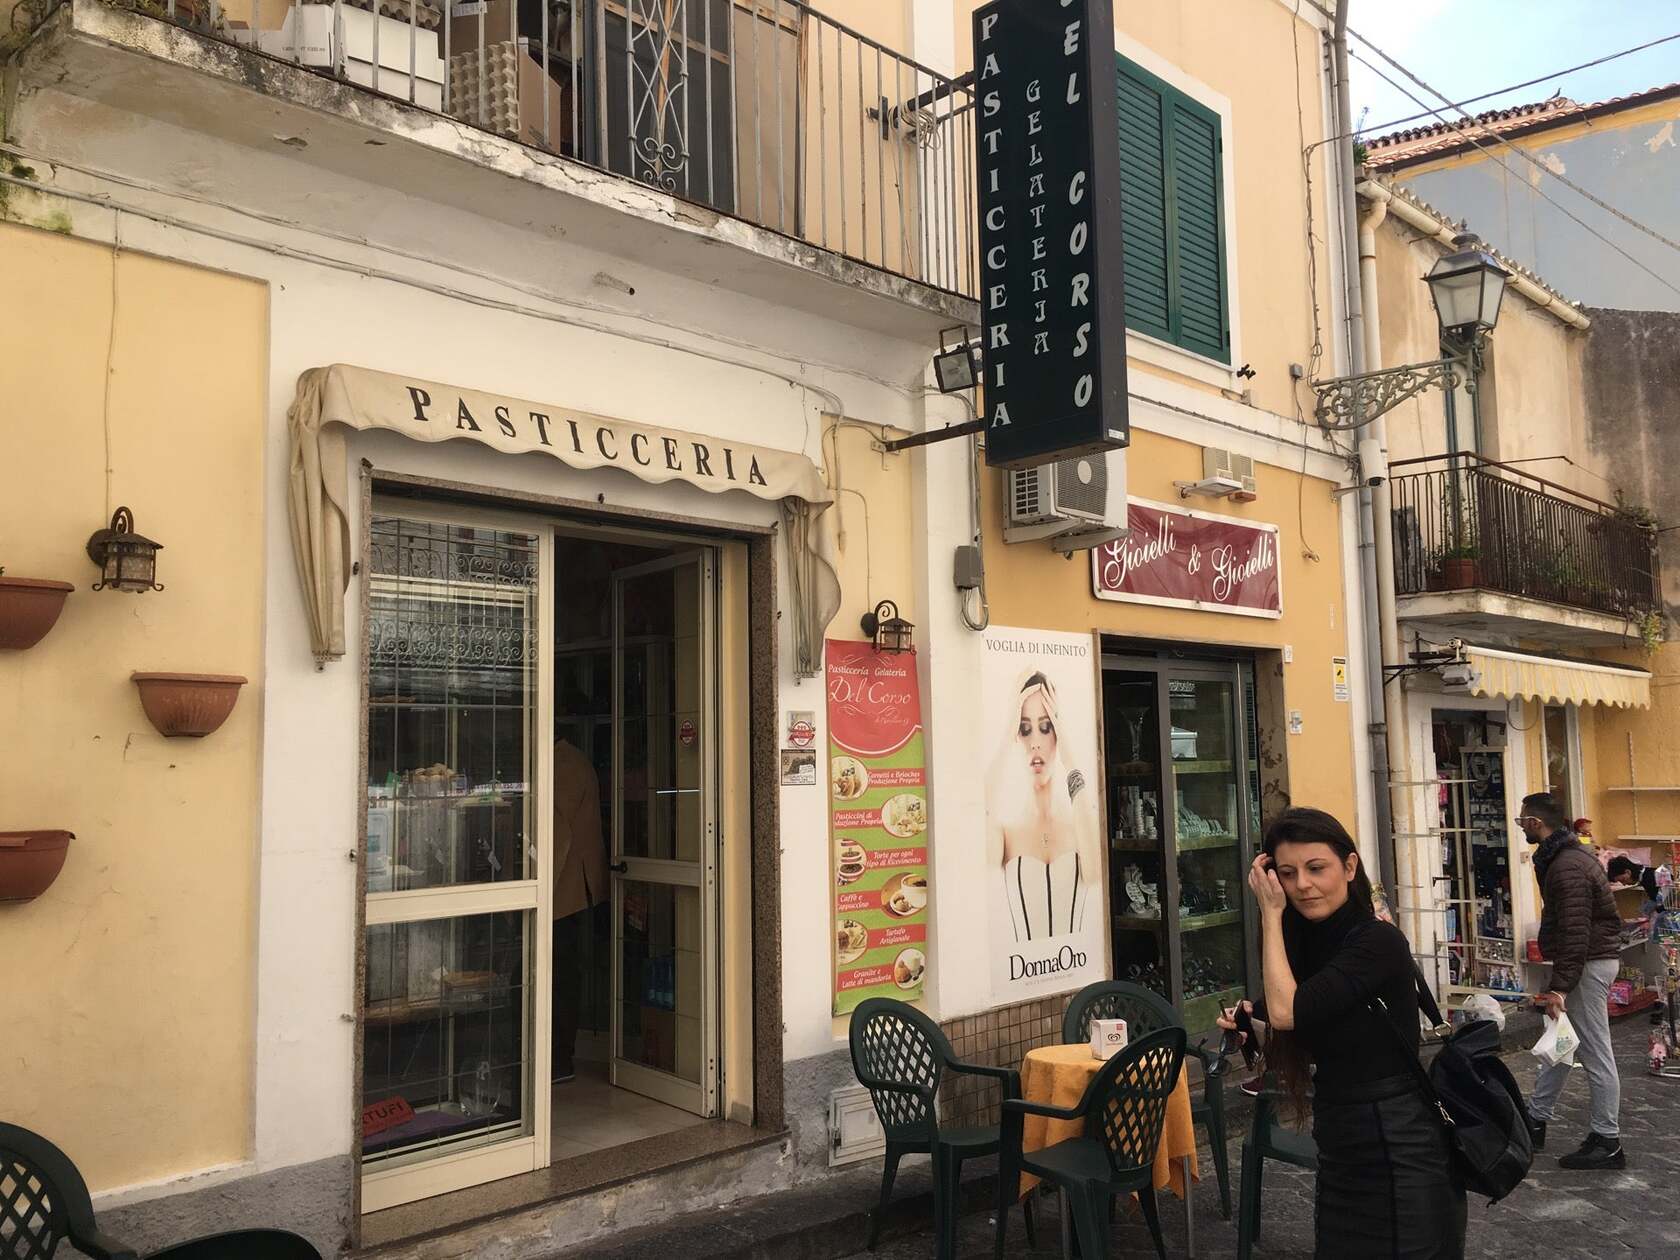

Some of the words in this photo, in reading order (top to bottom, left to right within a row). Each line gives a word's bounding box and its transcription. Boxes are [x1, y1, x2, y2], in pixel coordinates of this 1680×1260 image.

[1060, 0, 1081, 105] EL
[981, 13, 1012, 428] PASTICCERIA
[1068, 171, 1093, 408] CORSO
[405, 386, 768, 486] PASTICCERIA
[1104, 514, 1177, 589] Gioielli
[1188, 544, 1201, 576] &
[1211, 533, 1274, 602] Gioielli
[828, 664, 869, 676] Pasticceria
[874, 667, 907, 677] Gelateria
[986, 639, 1025, 653] VOGLIA
[1028, 642, 1039, 654] DI
[1042, 643, 1087, 657] INFINITO
[828, 676, 868, 703] Del
[868, 681, 911, 704] Corso
[874, 851, 889, 859] Torte
[889, 852, 900, 860] per
[1009, 945, 1087, 981] DonnaOro
